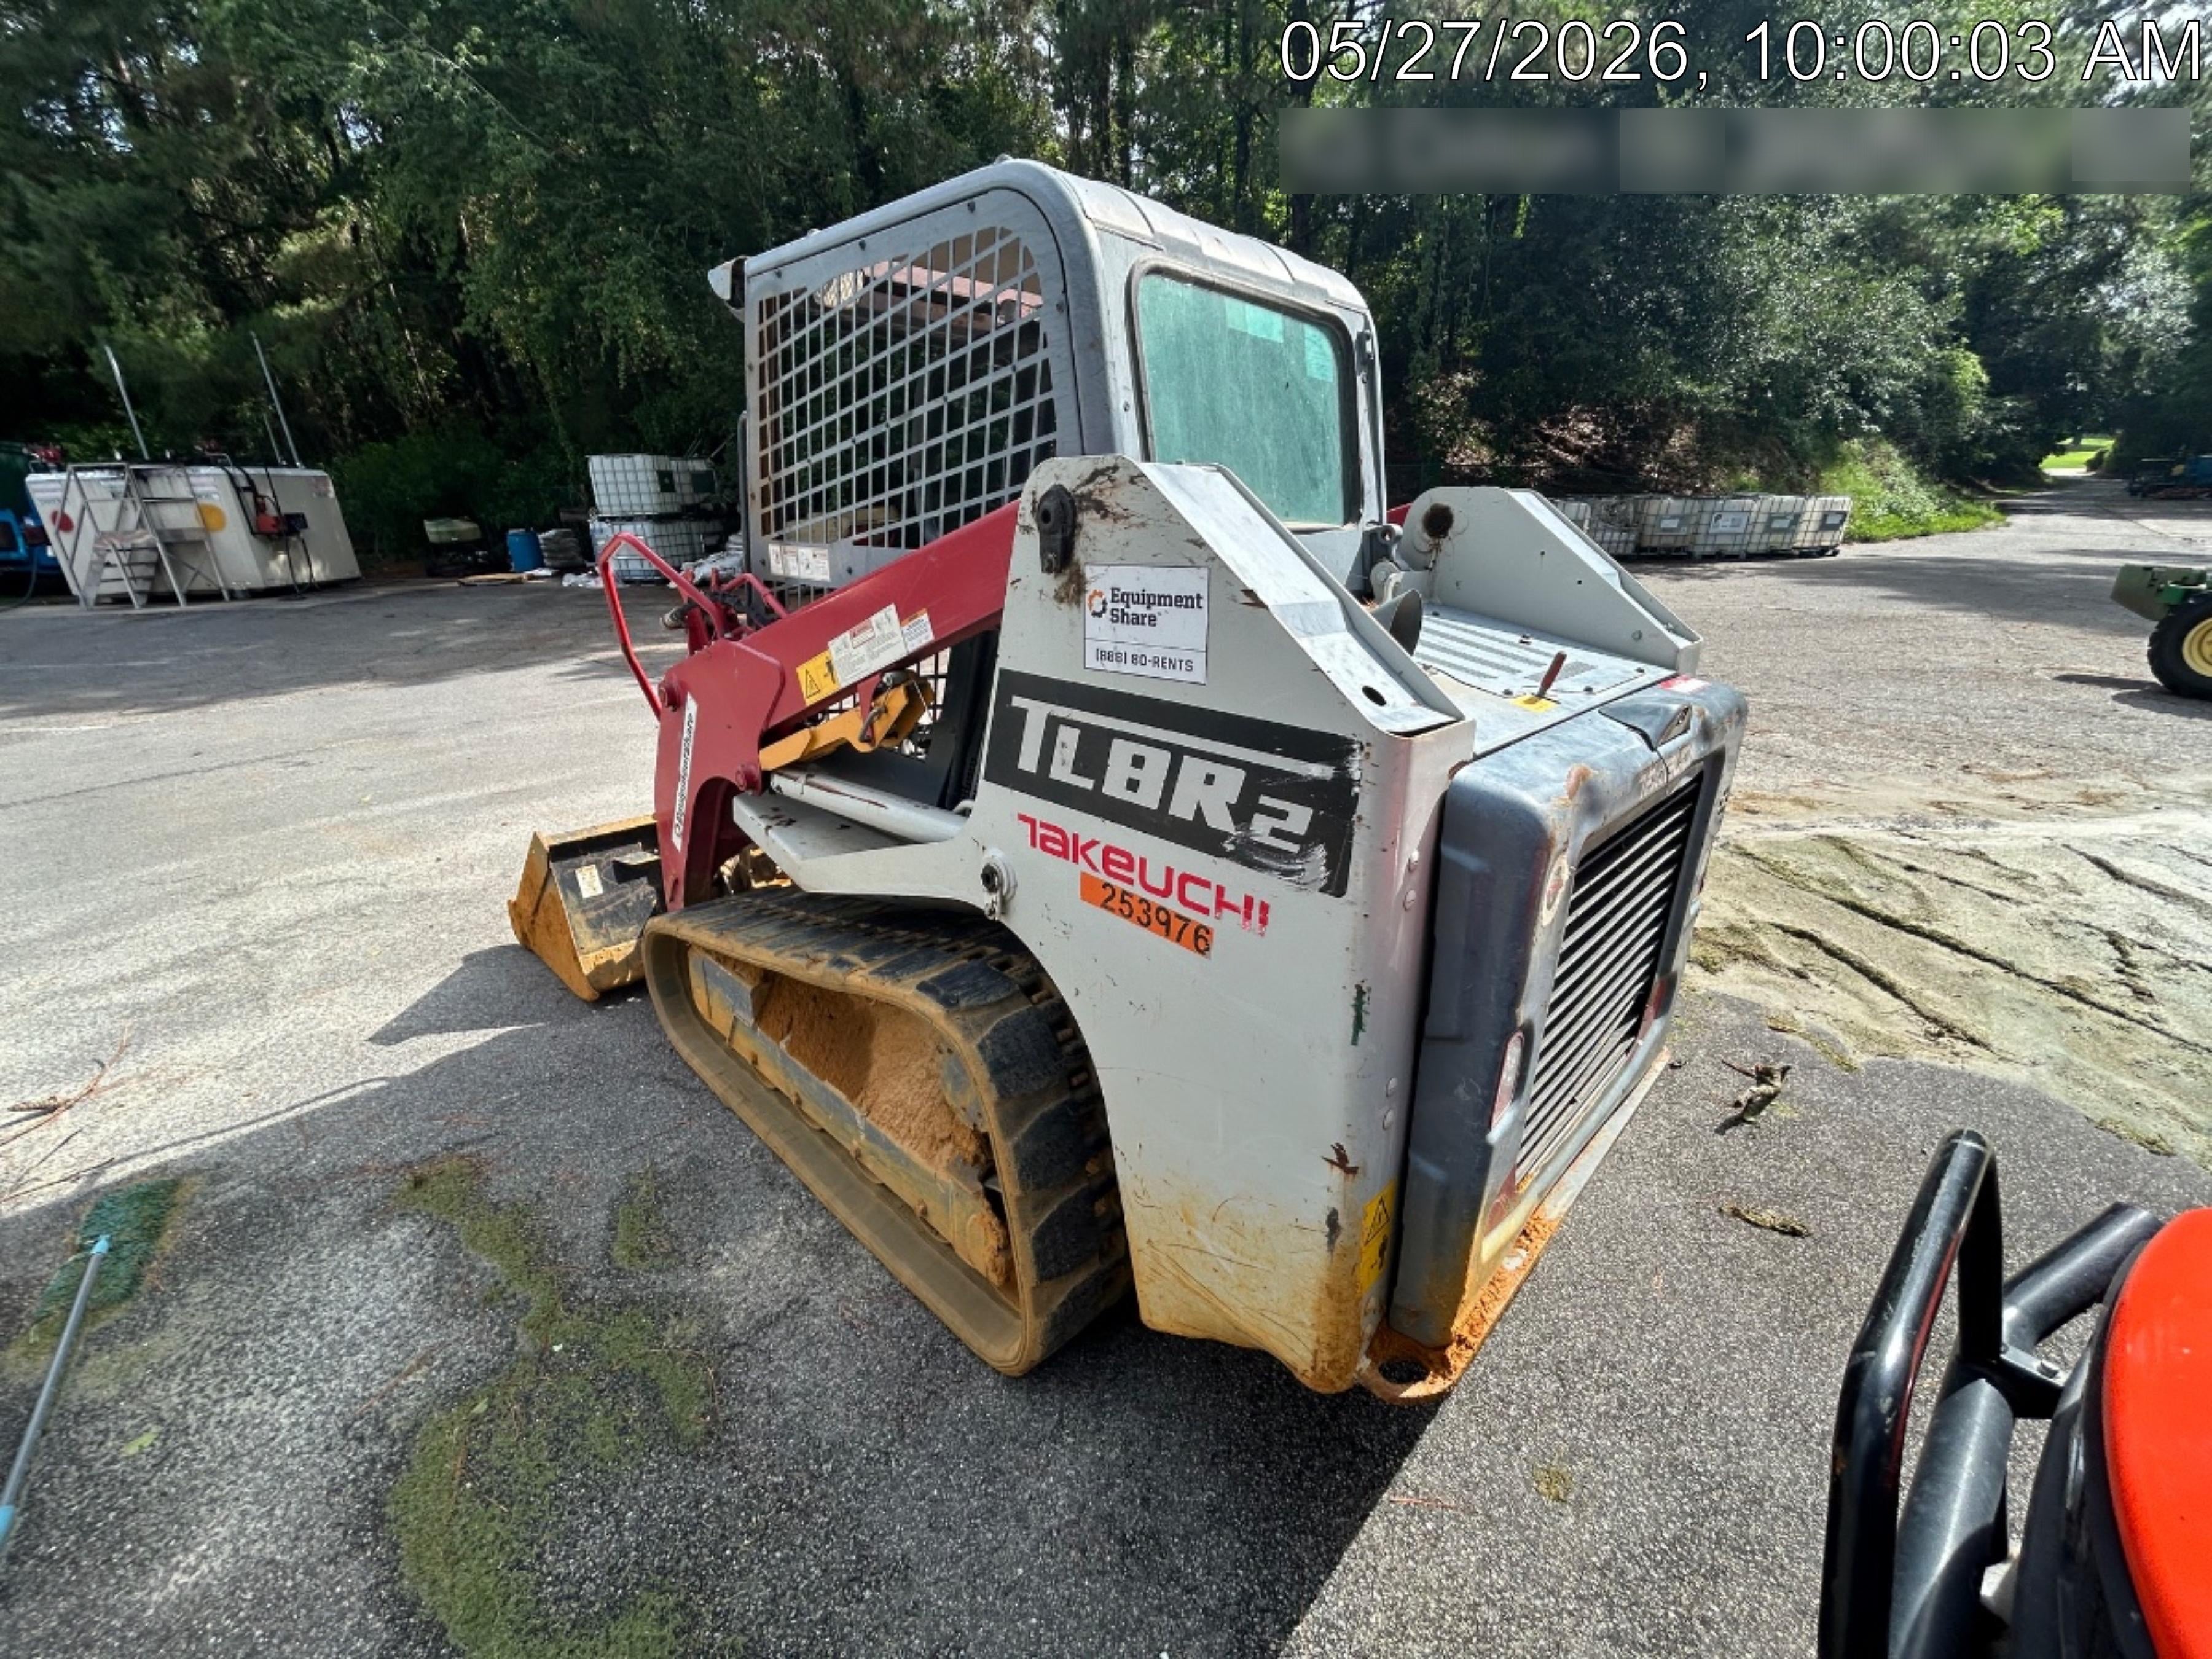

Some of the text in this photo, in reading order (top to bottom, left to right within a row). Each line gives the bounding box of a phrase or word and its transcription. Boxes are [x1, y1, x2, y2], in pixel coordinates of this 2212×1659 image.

[1110, 587, 1204, 610] Equipment
[1110, 608, 1157, 627] Share
[1131, 654, 1193, 672] 80-RENTS
[1100, 882, 1211, 955] 253976
